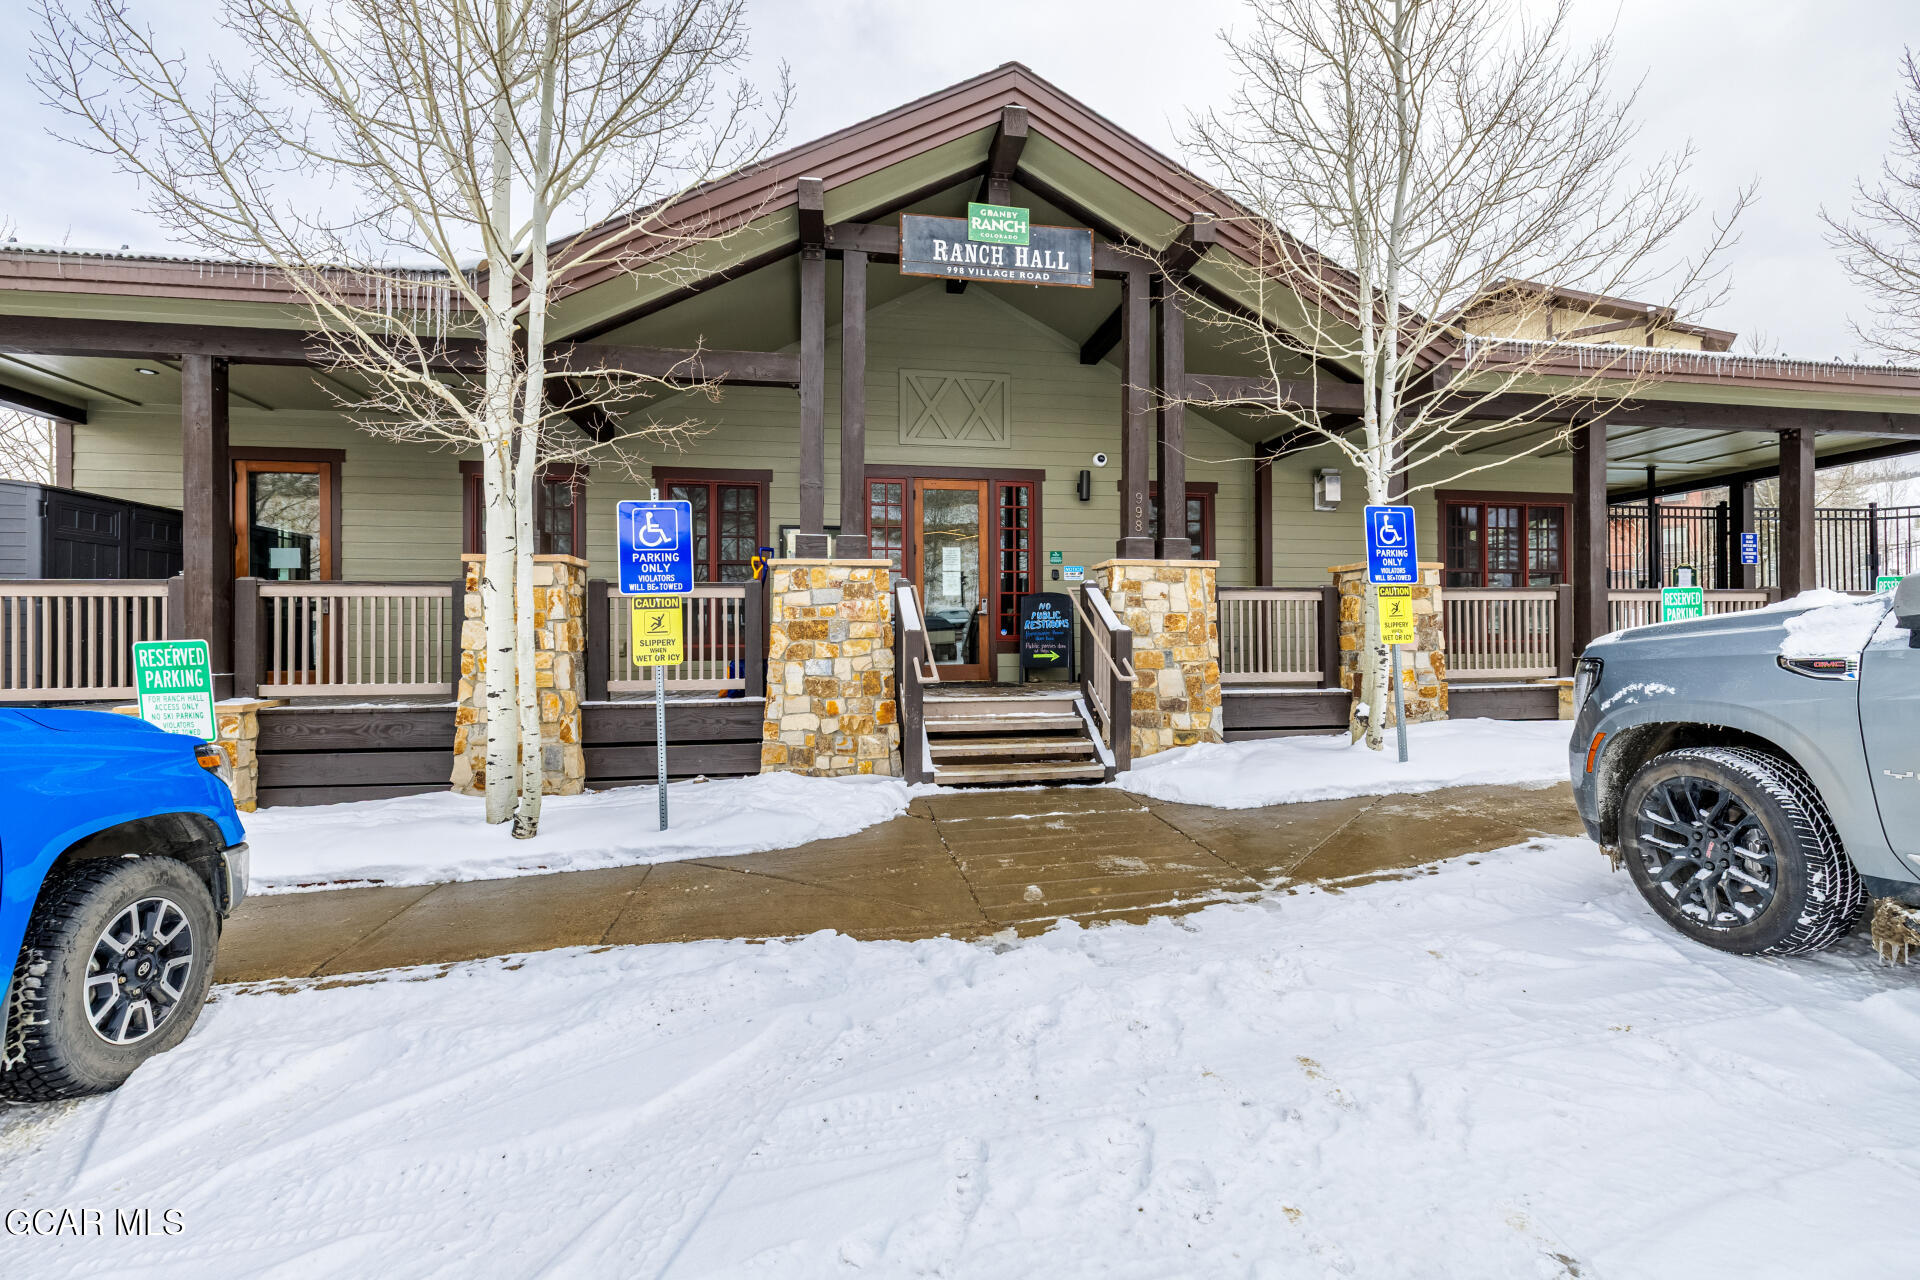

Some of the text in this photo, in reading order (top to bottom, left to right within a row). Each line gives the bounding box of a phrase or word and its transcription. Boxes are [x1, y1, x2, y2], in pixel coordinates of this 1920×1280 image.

[980, 208, 1018, 219] GRANBY
[971, 217, 1027, 234] RANCH
[980, 232, 1018, 240] COLORADO
[933, 239, 1069, 270] RANCH HALL
[946, 266, 1050, 281] 998 VILLAGE ROAD
[1135, 492, 1143, 532] 998
[632, 552, 680, 562] PARKING
[1376, 549, 1408, 557] PARKING
[1382, 558, 1403, 566] ONLY
[641, 563, 671, 573] ONLY
[638, 574, 675, 583] VIOLATORS
[629, 582, 683, 591] WILL BE TOWED
[1380, 587, 1409, 596] CAUTION
[635, 598, 679, 608] CAUTION
[1664, 592, 1701, 606] RESERVED
[1038, 602, 1052, 611] NO
[1031, 610, 1062, 620] PUBLIC
[1667, 607, 1699, 621] PARKING
[1024, 618, 1070, 630] RESTROOMS
[639, 638, 676, 647] SLIPPERY
[138, 647, 205, 667] RESERVED
[636, 653, 681, 662] WET OR ICY
[144, 669, 204, 688] PARKING
[148, 695, 161, 703] FOR
[152, 711, 204, 720] NO SKI PARKING
